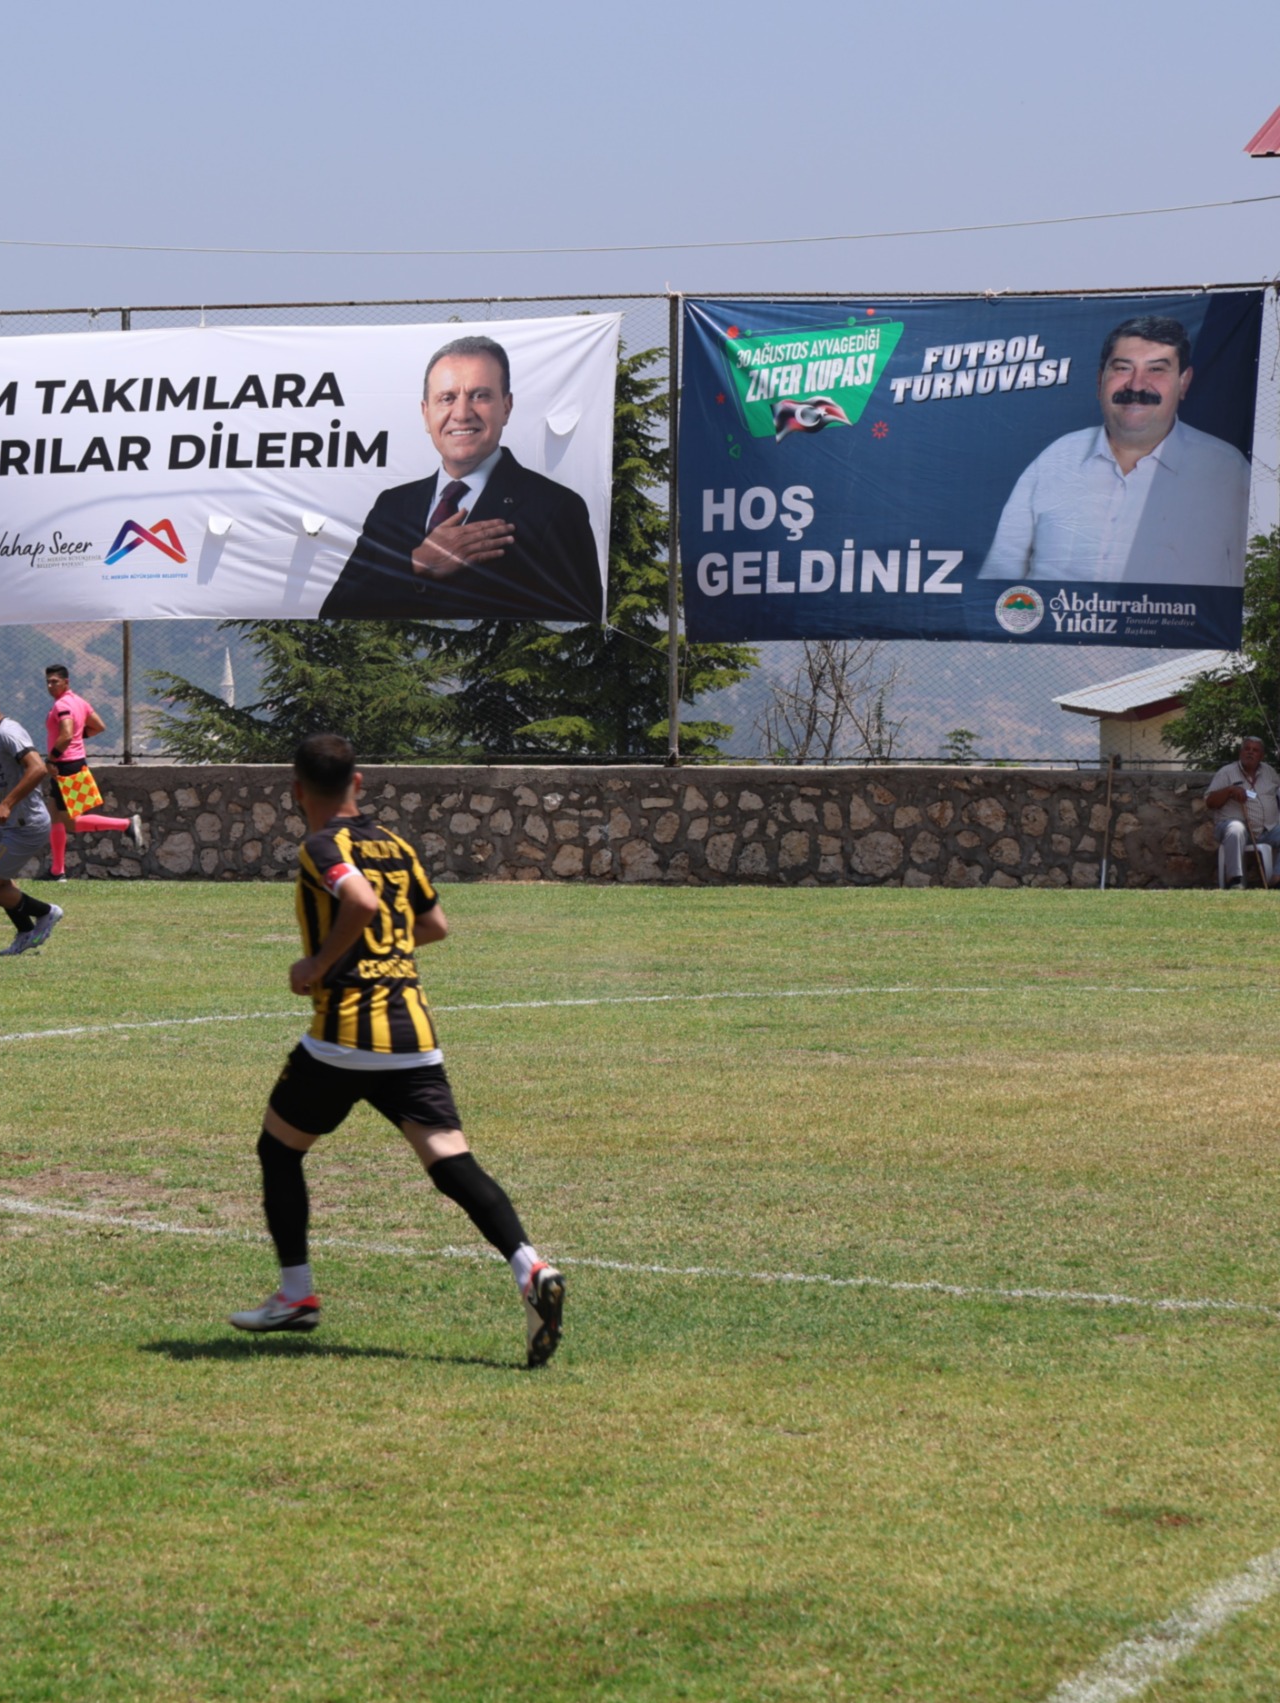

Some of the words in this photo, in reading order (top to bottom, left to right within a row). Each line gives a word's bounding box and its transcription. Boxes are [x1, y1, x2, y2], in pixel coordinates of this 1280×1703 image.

[736, 350, 751, 369] 30
[751, 341, 810, 367] AĞUSTOS
[810, 328, 881, 359] AYVAGEDİĞİ
[921, 334, 1046, 374] FUTBOL
[34, 371, 346, 416] TAKIMLARA
[745, 363, 803, 403] ZAFER
[804, 353, 877, 393] KUPASI
[889, 357, 1072, 405] TURNUVASI
[168, 418, 390, 470] DİLERİM
[700, 485, 815, 541] HOŞ
[696, 539, 964, 596] GELDİNİZ
[1049, 588, 1197, 616] Abdurrahman
[1050, 611, 1118, 634] Yıldız
